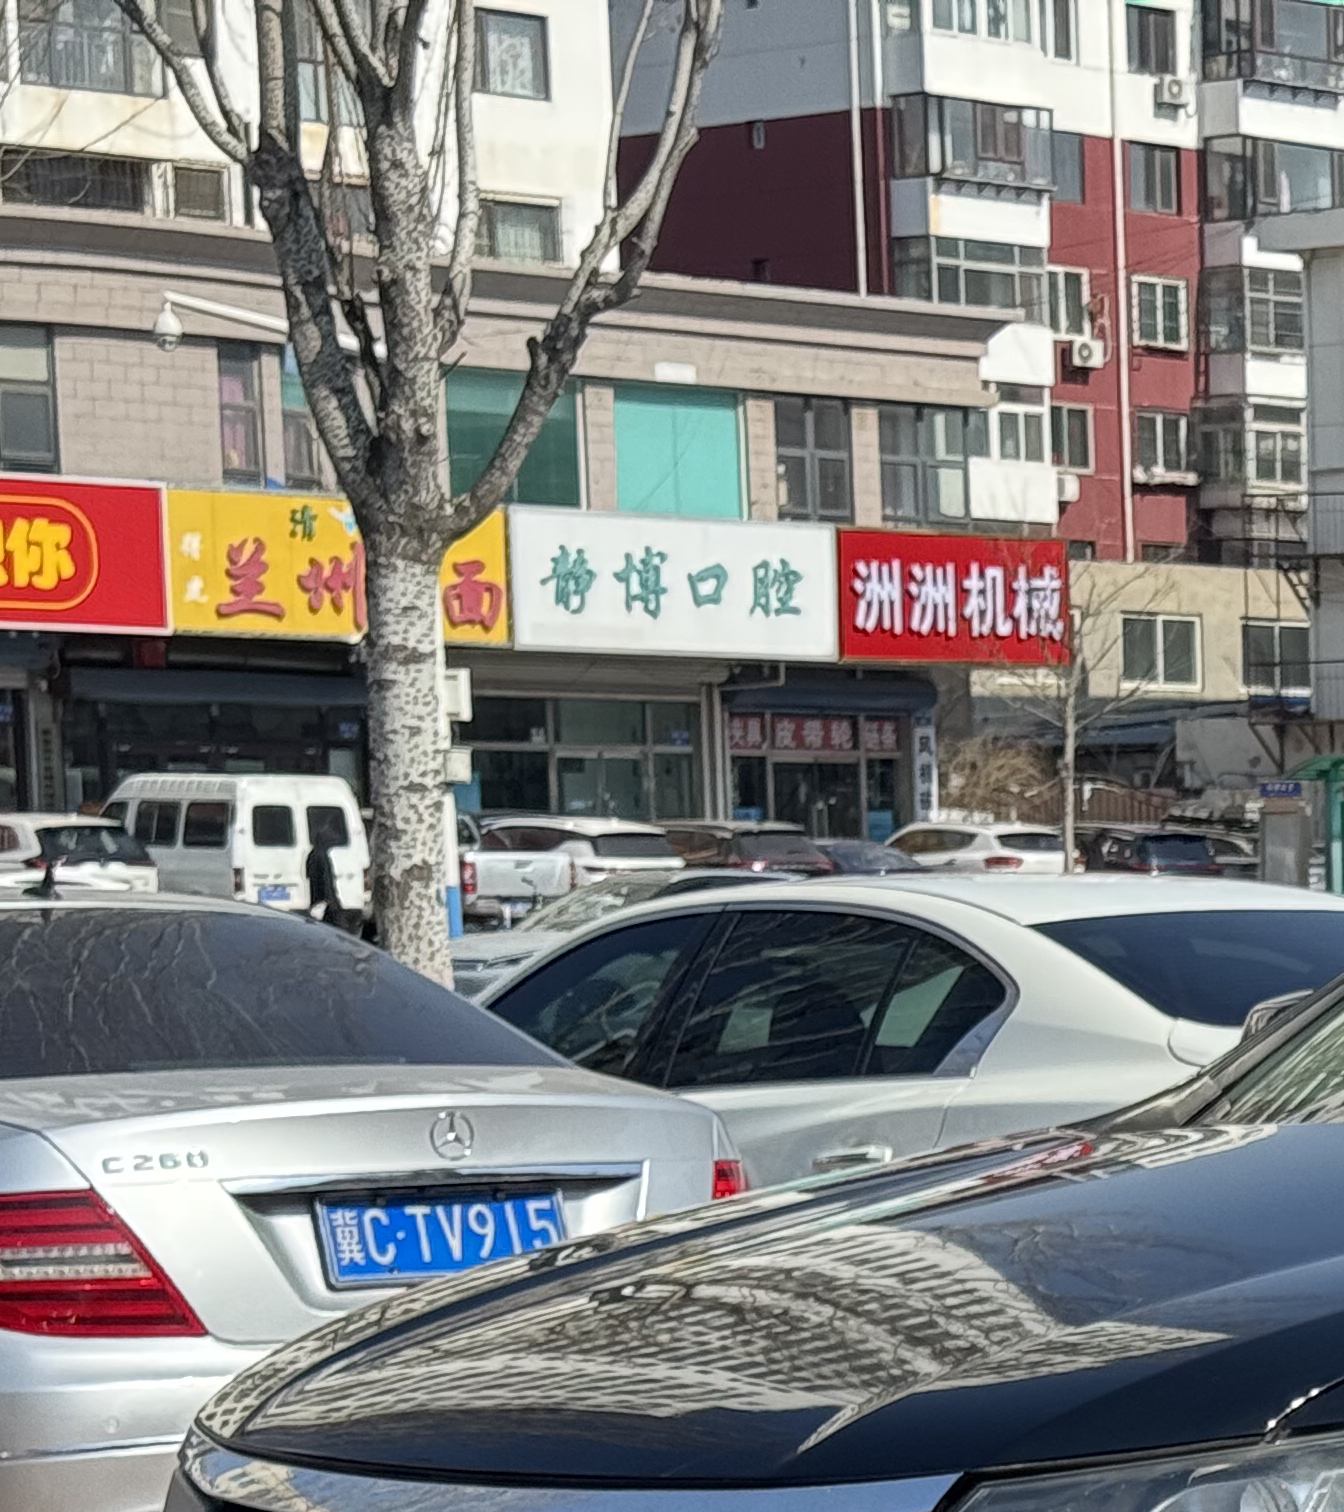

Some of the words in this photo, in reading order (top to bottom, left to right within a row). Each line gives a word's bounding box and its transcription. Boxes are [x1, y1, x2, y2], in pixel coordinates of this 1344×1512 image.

[0, 517, 76, 590] 你
[216, 537, 501, 633] 兰州面
[540, 545, 803, 619] 静博口腔
[850, 557, 1066, 642] 洲洲机械
